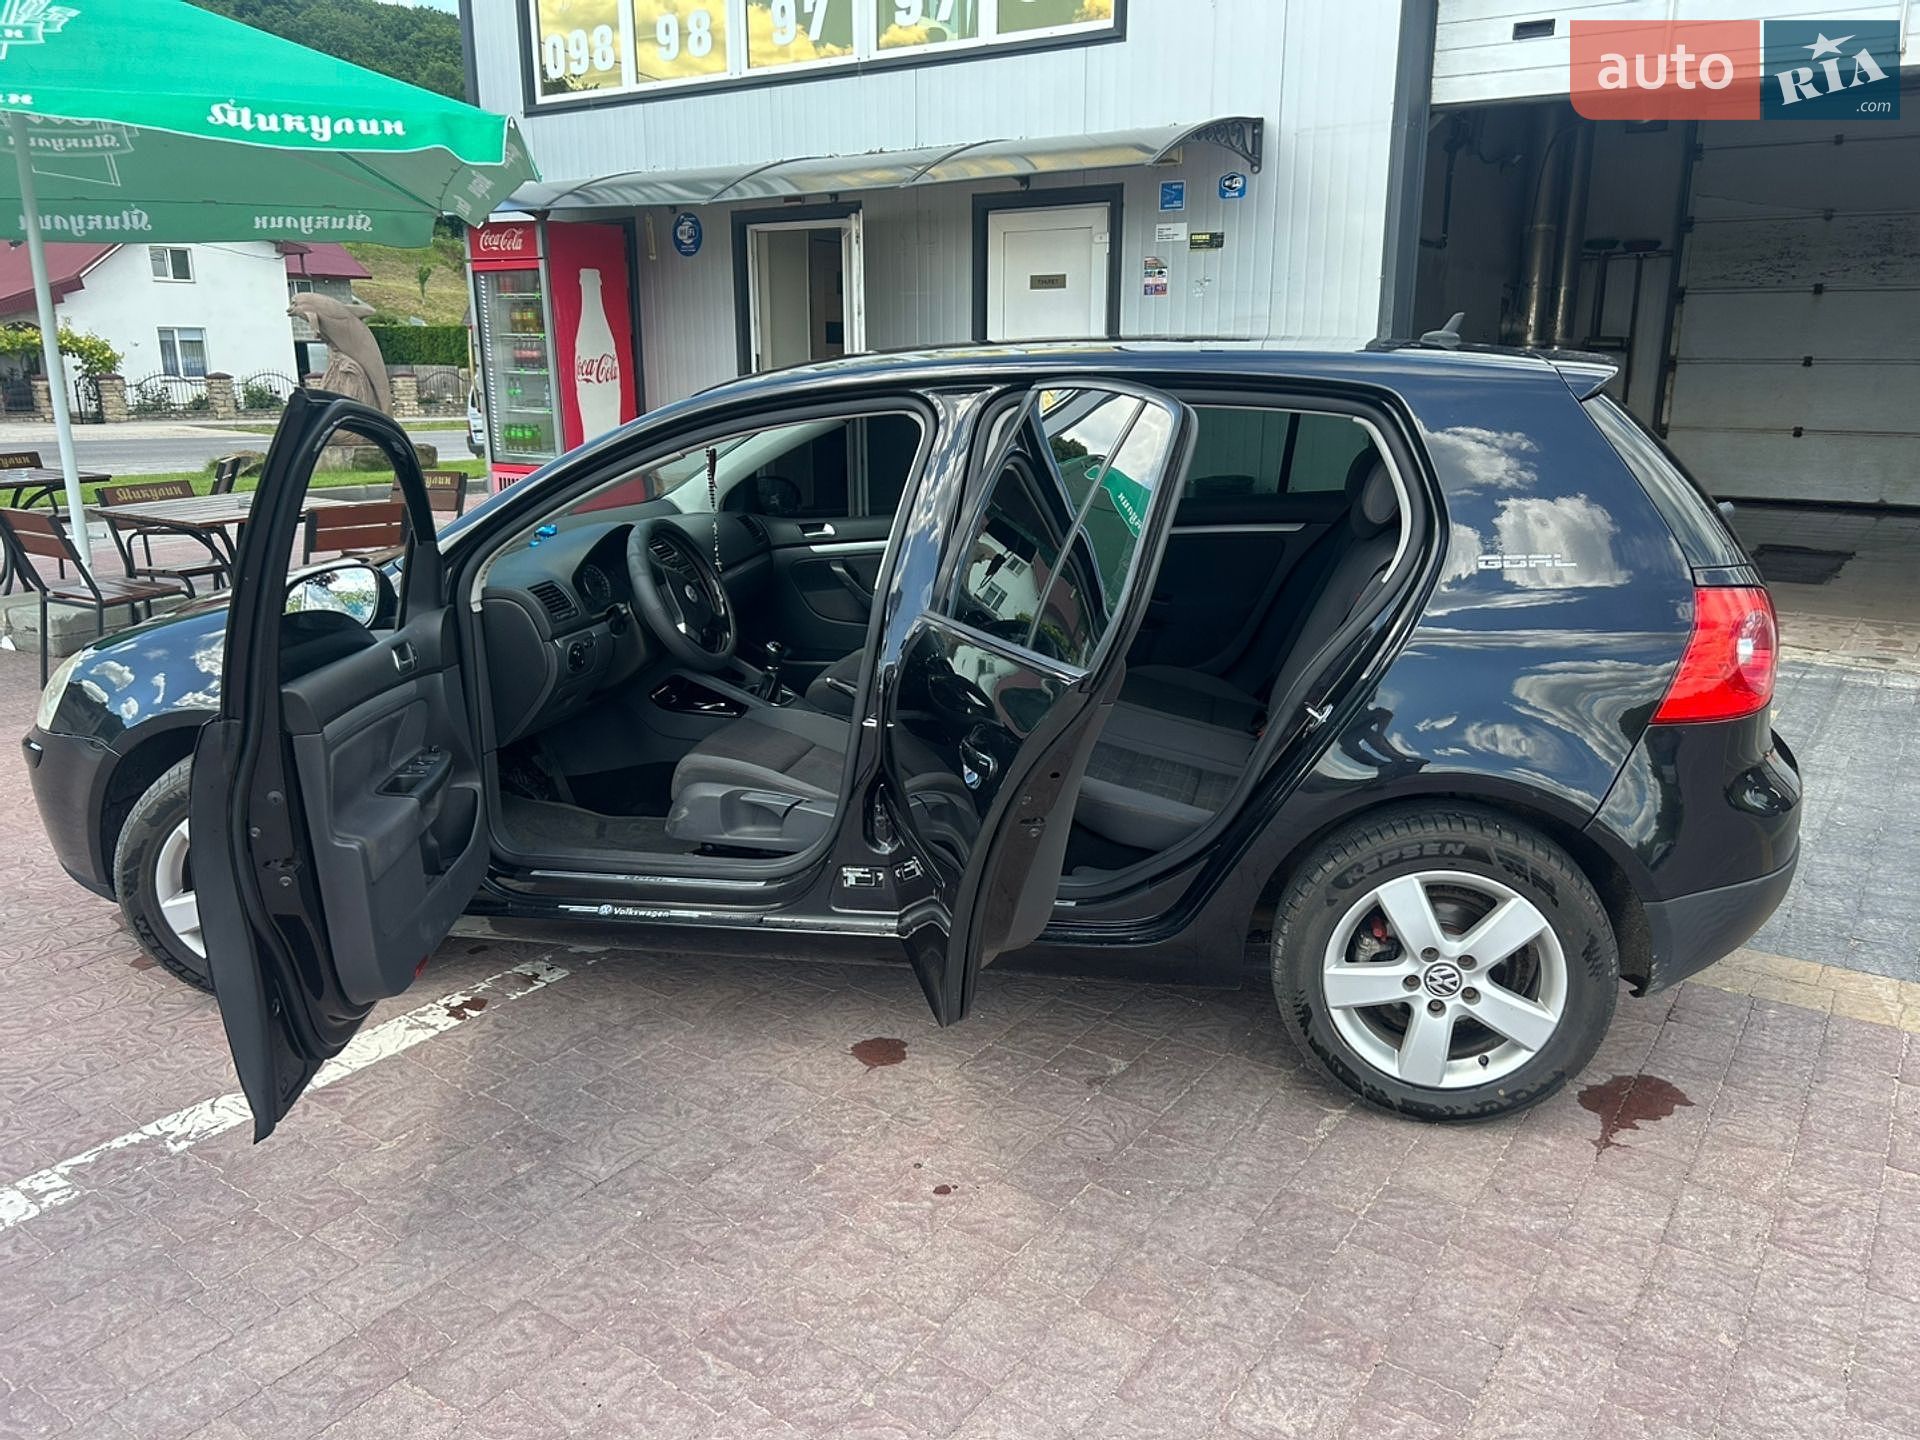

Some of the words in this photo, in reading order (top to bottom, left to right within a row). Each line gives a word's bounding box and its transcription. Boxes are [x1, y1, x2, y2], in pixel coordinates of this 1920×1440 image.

[544, 24, 615, 80] 098
[655, 9, 712, 61] 98
[771, 0, 828, 46] 97
[206, 98, 406, 141] Микулин
[614, 907, 670, 918] Volkswagen
